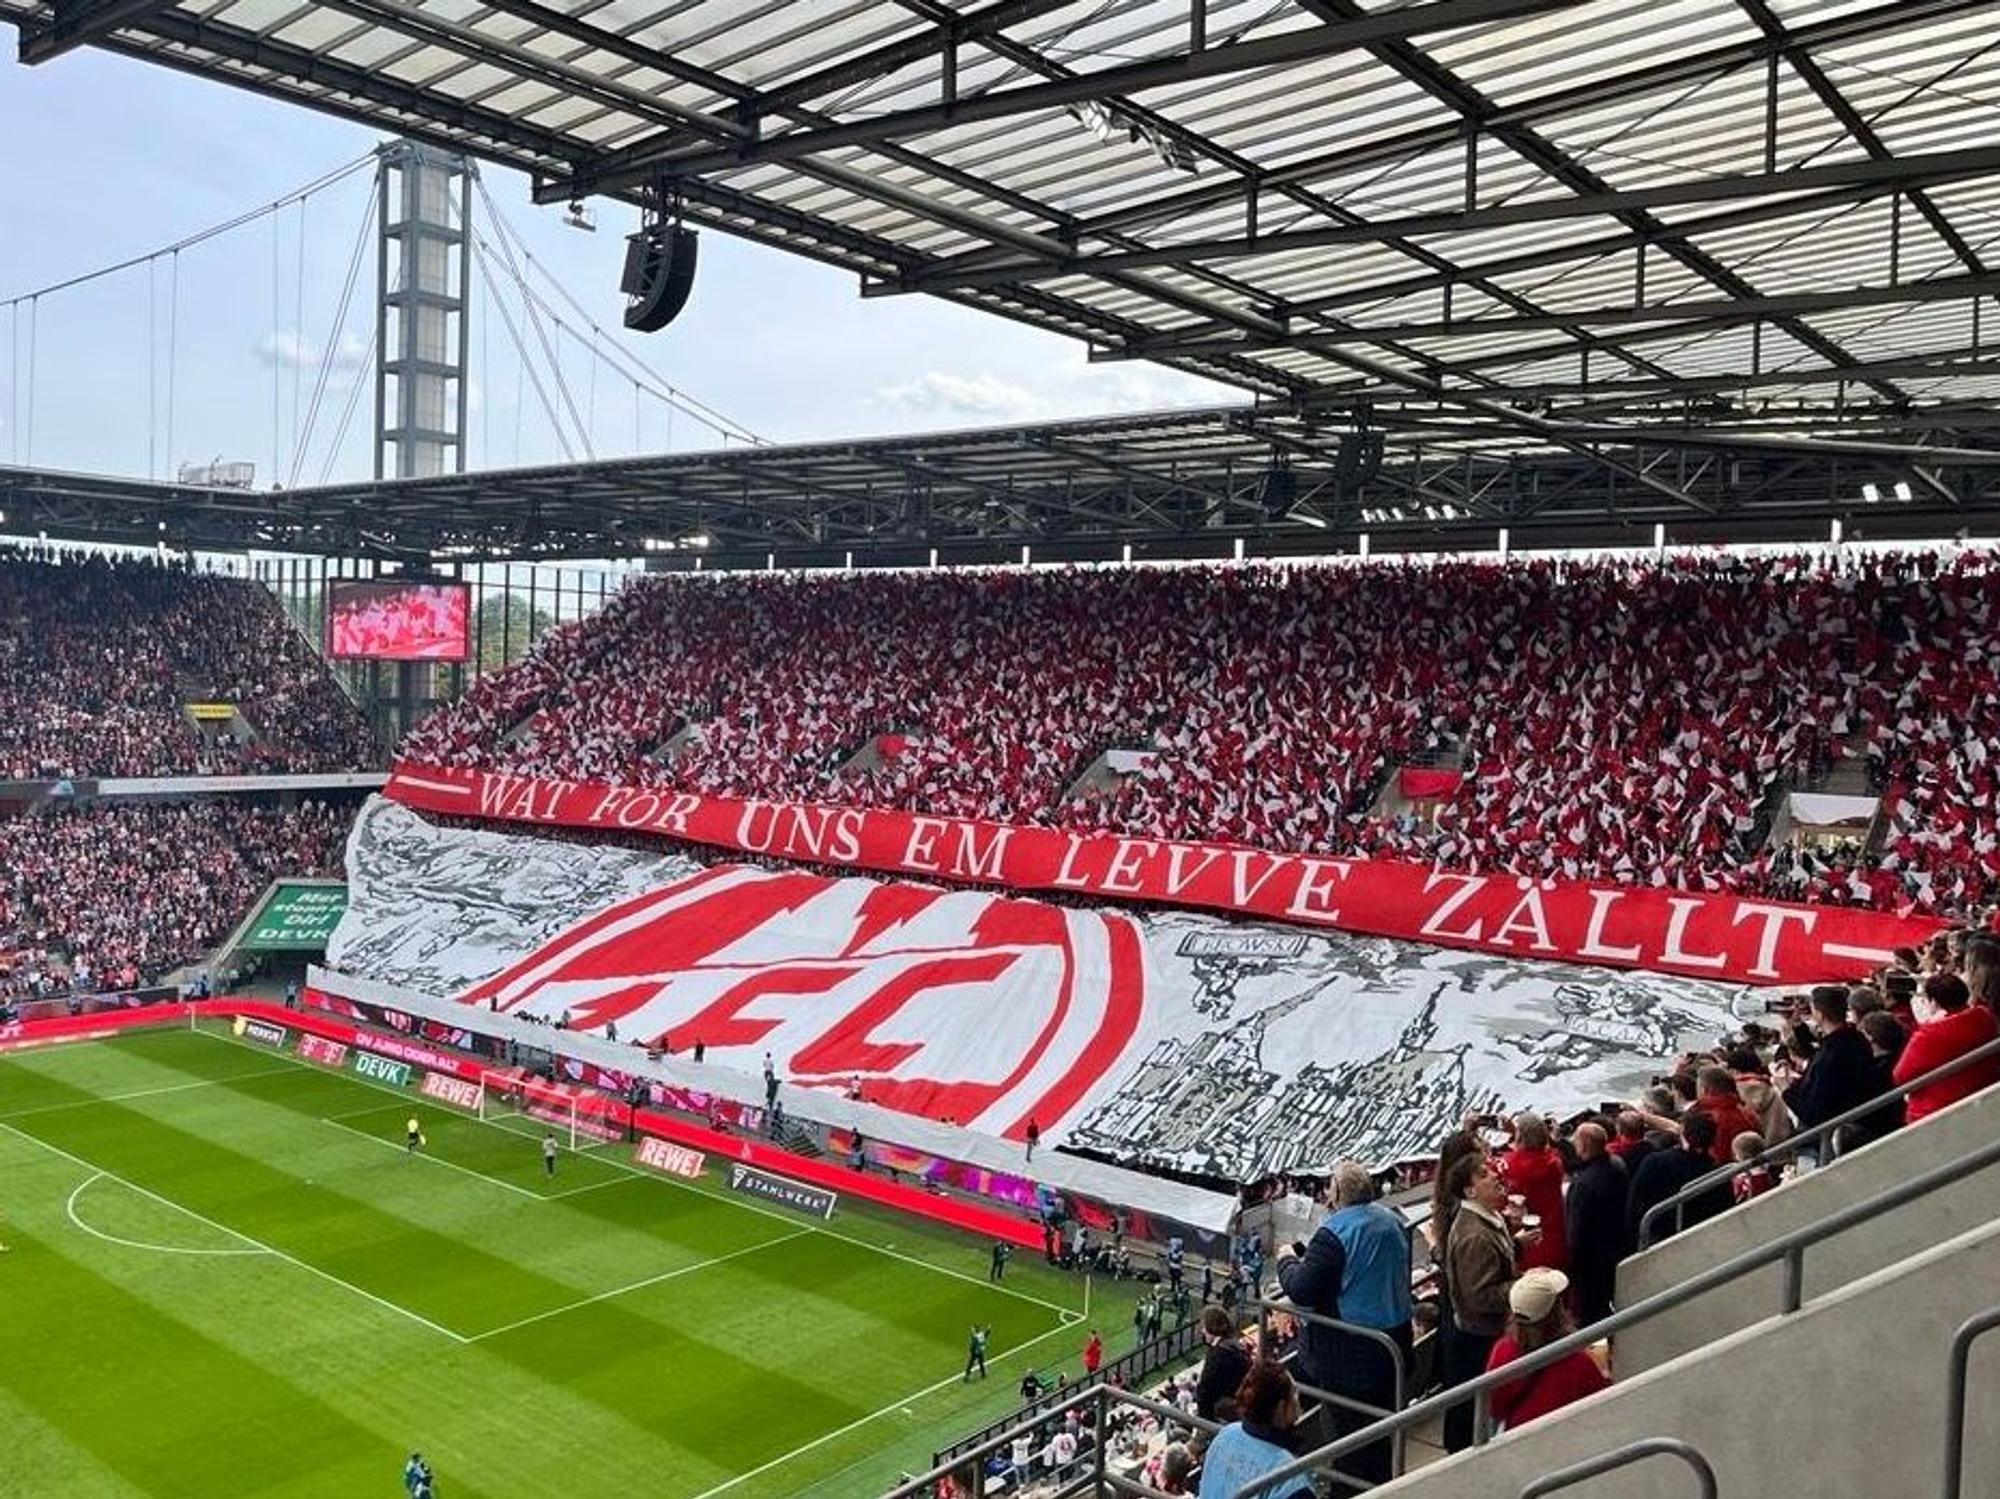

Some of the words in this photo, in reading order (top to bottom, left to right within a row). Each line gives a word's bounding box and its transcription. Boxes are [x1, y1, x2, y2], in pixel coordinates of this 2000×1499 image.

[479, 773, 575, 820] WAT
[737, 799, 867, 862] UNS
[900, 816, 1016, 881] EM
[1053, 834, 1352, 922] LEVVE
[1420, 871, 1817, 979] ZÄLLT
[257, 928, 331, 939] DEVK
[356, 1055, 400, 1081] DEVK
[423, 1075, 475, 1106] REWE
[640, 1141, 693, 1176] REWE
